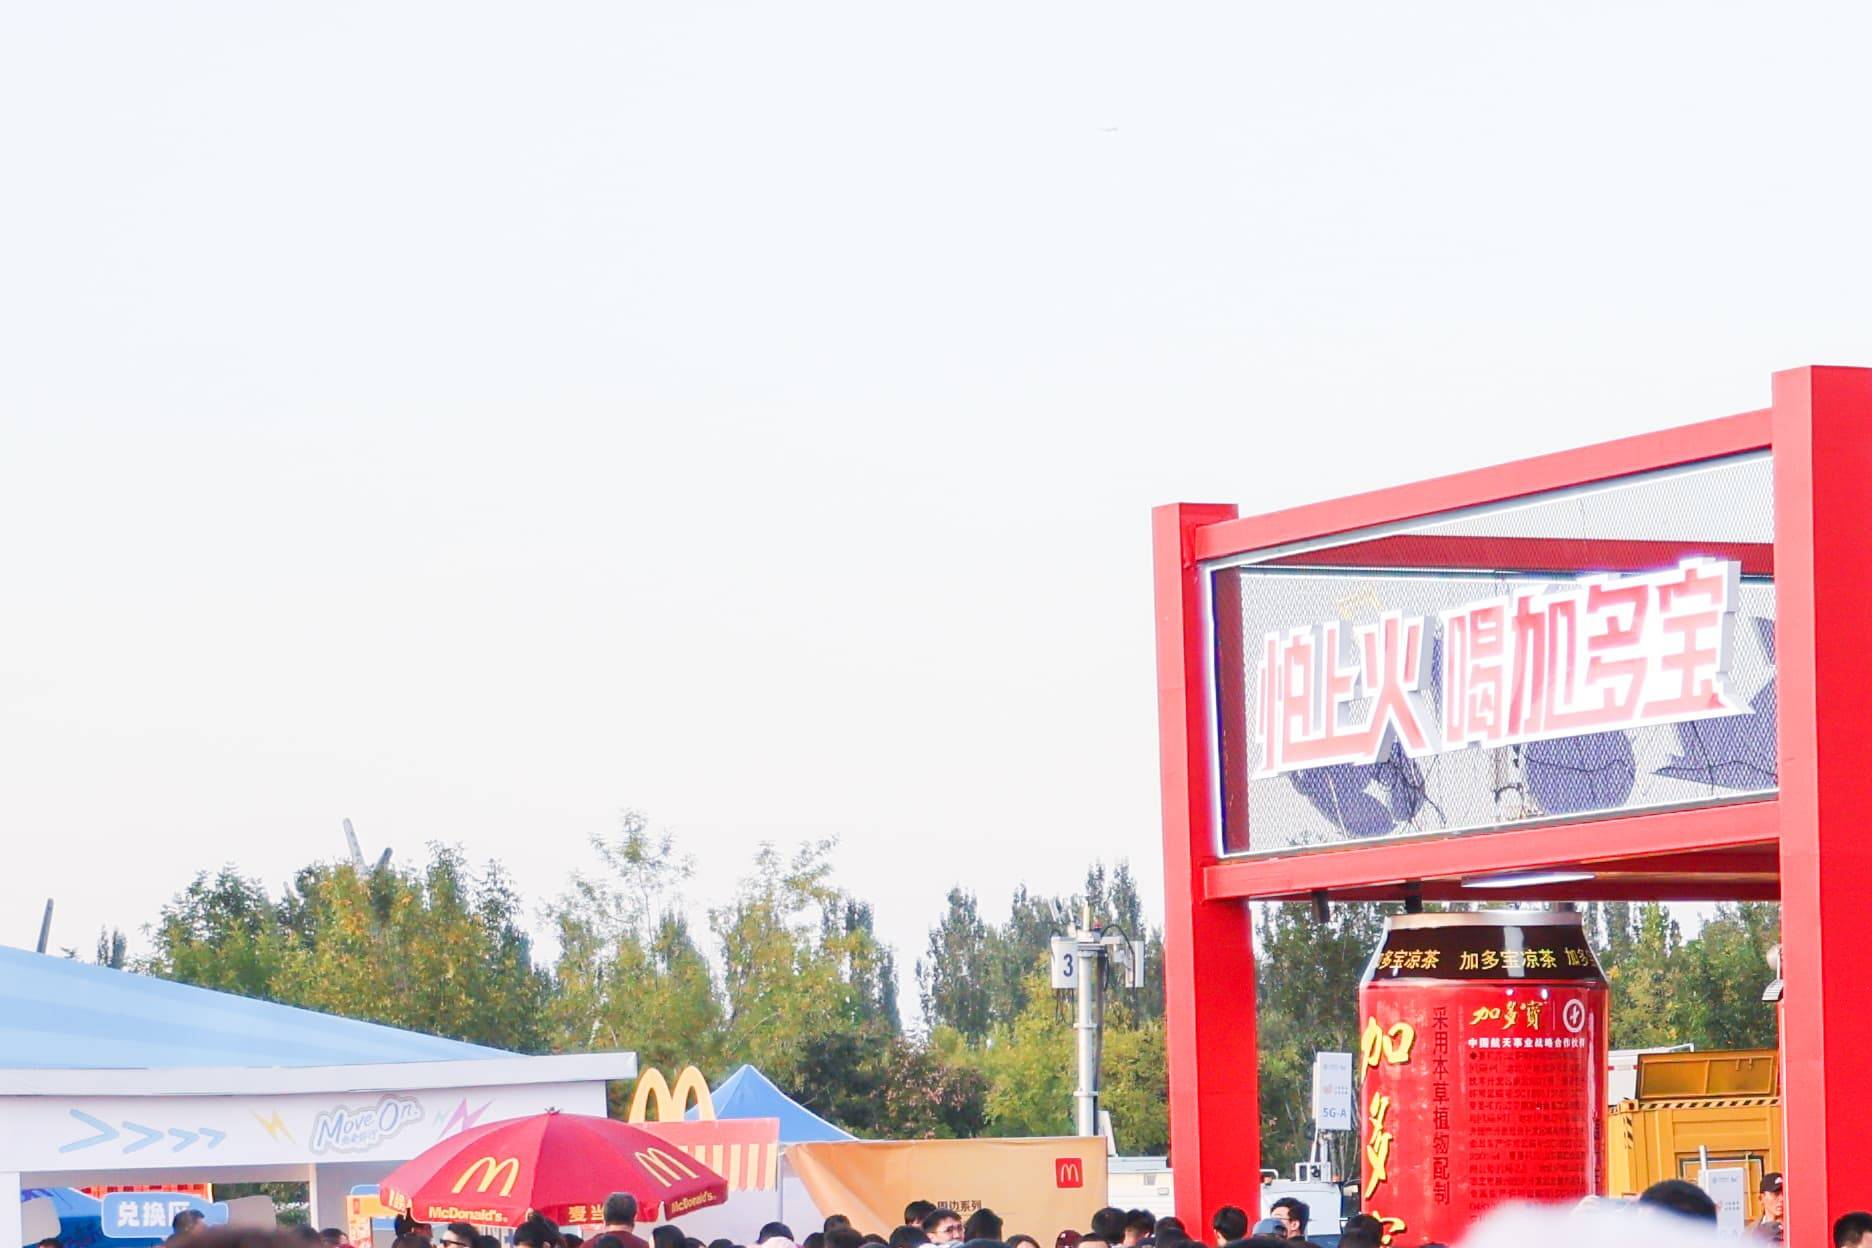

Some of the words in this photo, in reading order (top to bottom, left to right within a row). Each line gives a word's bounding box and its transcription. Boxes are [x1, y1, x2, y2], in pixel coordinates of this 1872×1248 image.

[1063, 953, 1074, 977] 3
[1378, 949, 1441, 970] 多宝凉茶
[1458, 948, 1558, 971] 加多宝凉茶
[317, 1113, 373, 1147] Move
